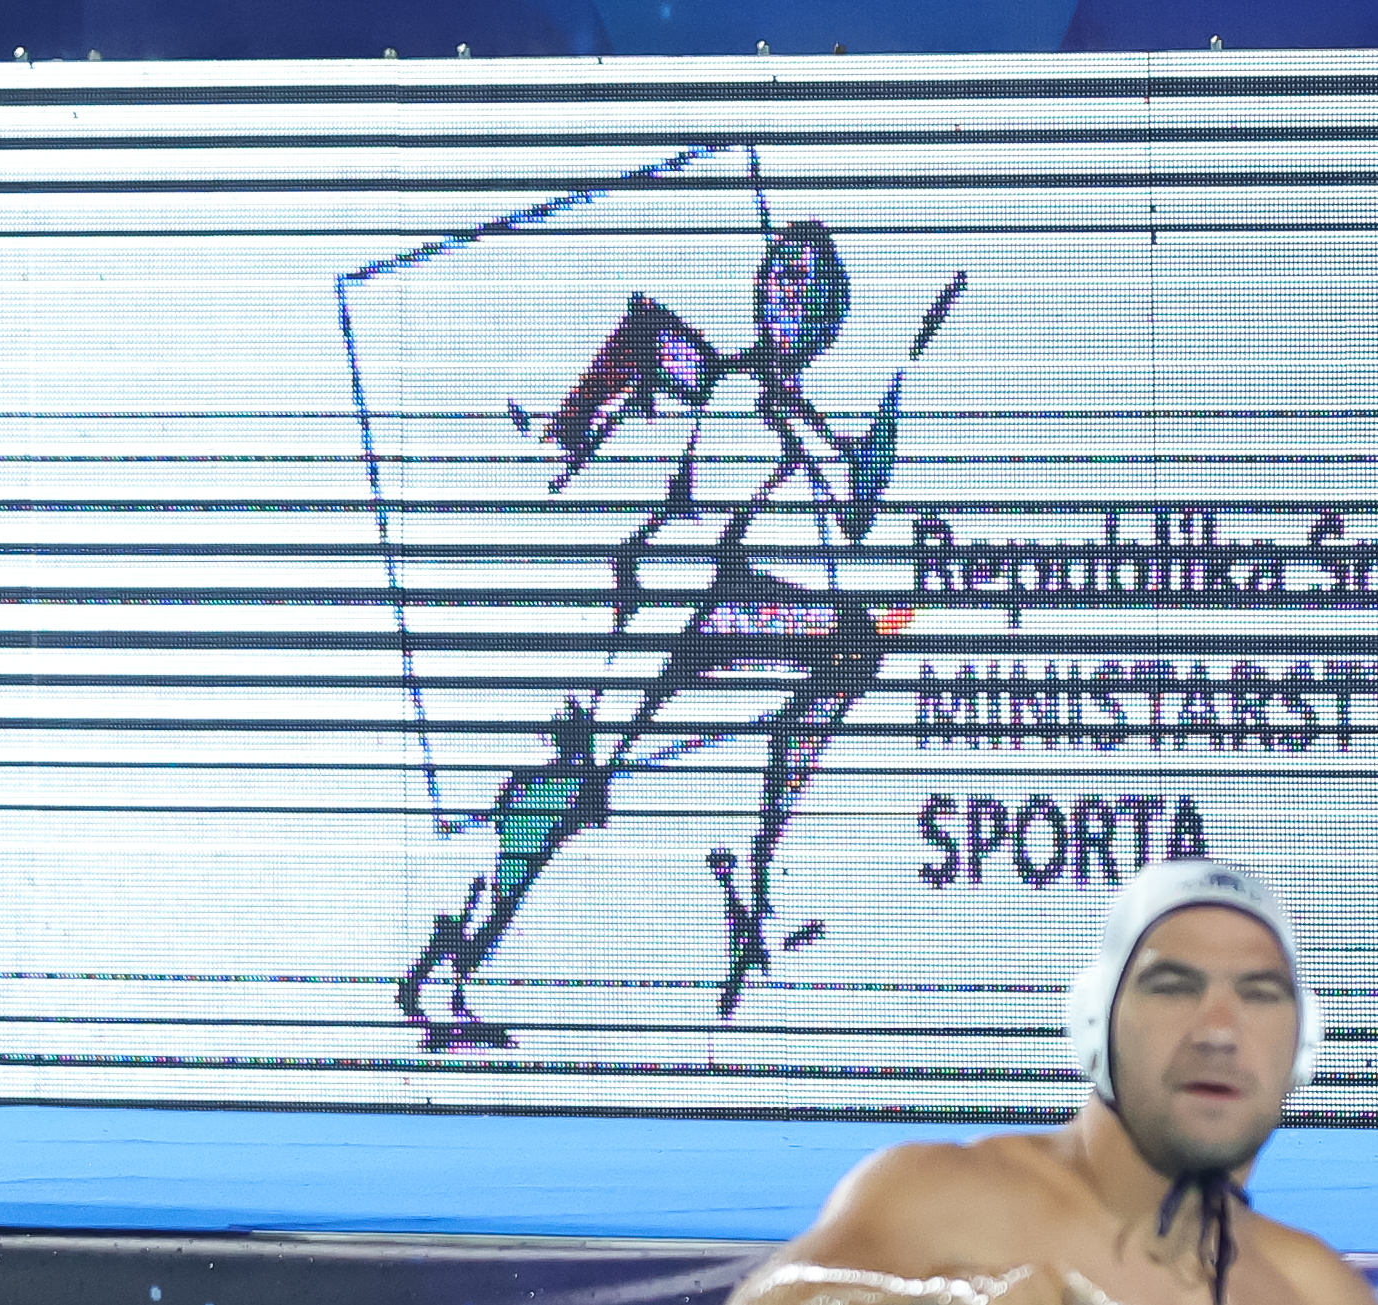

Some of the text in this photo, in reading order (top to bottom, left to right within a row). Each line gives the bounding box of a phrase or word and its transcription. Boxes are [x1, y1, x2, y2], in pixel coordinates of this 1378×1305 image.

[912, 509, 1285, 628] Republika
[917, 659, 1378, 752] MINISTARST
[917, 794, 1209, 890] SPORTA
